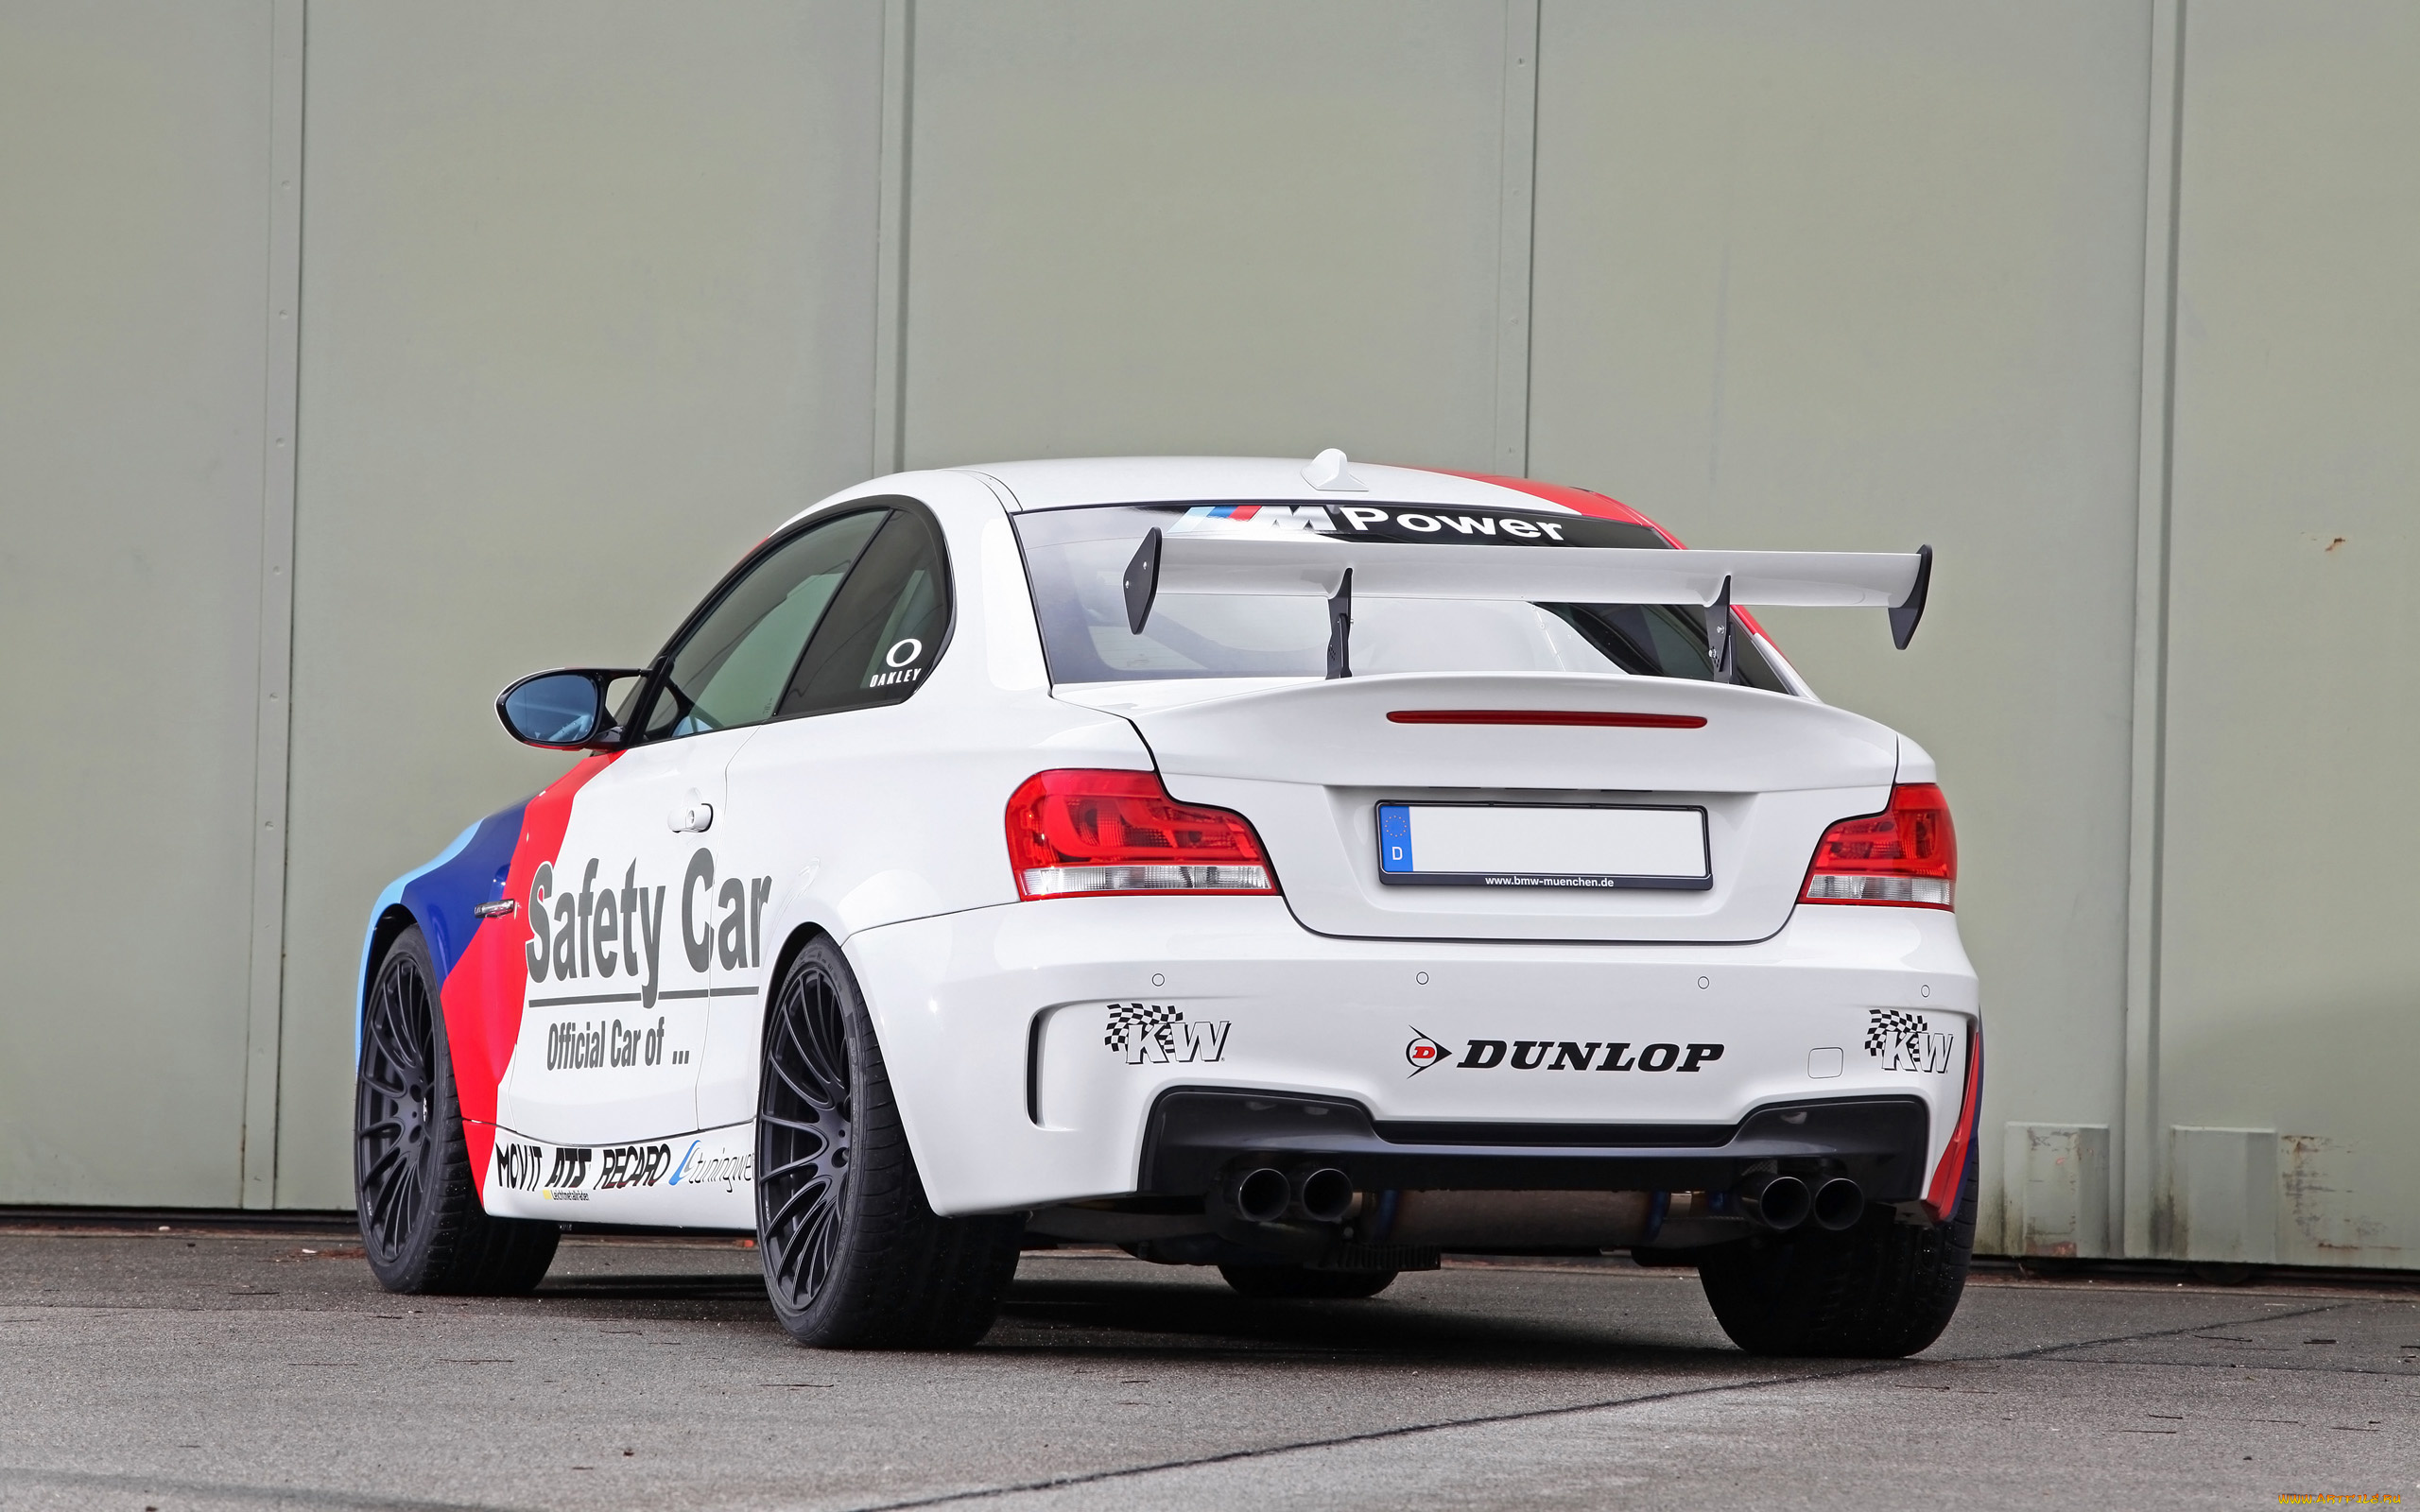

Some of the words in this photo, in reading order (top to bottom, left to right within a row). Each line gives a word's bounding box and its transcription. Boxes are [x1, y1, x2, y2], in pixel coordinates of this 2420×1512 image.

[1341, 507, 1568, 541] Power
[870, 668, 922, 688] OAKLEY
[1392, 846, 1403, 861] D
[1485, 875, 1615, 888] www.bmw-muenchen.de
[526, 857, 666, 1009] Safety
[682, 847, 772, 973] Car
[546, 1020, 606, 1072] Official
[610, 1019, 641, 1069] Car
[645, 1016, 666, 1067] of
[1126, 1021, 1232, 1065] KW
[1457, 1040, 1725, 1073] DUNLOP
[1881, 1030, 1954, 1074] KW
[544, 1147, 592, 1188] ATS
[594, 1143, 671, 1191] RECARO
